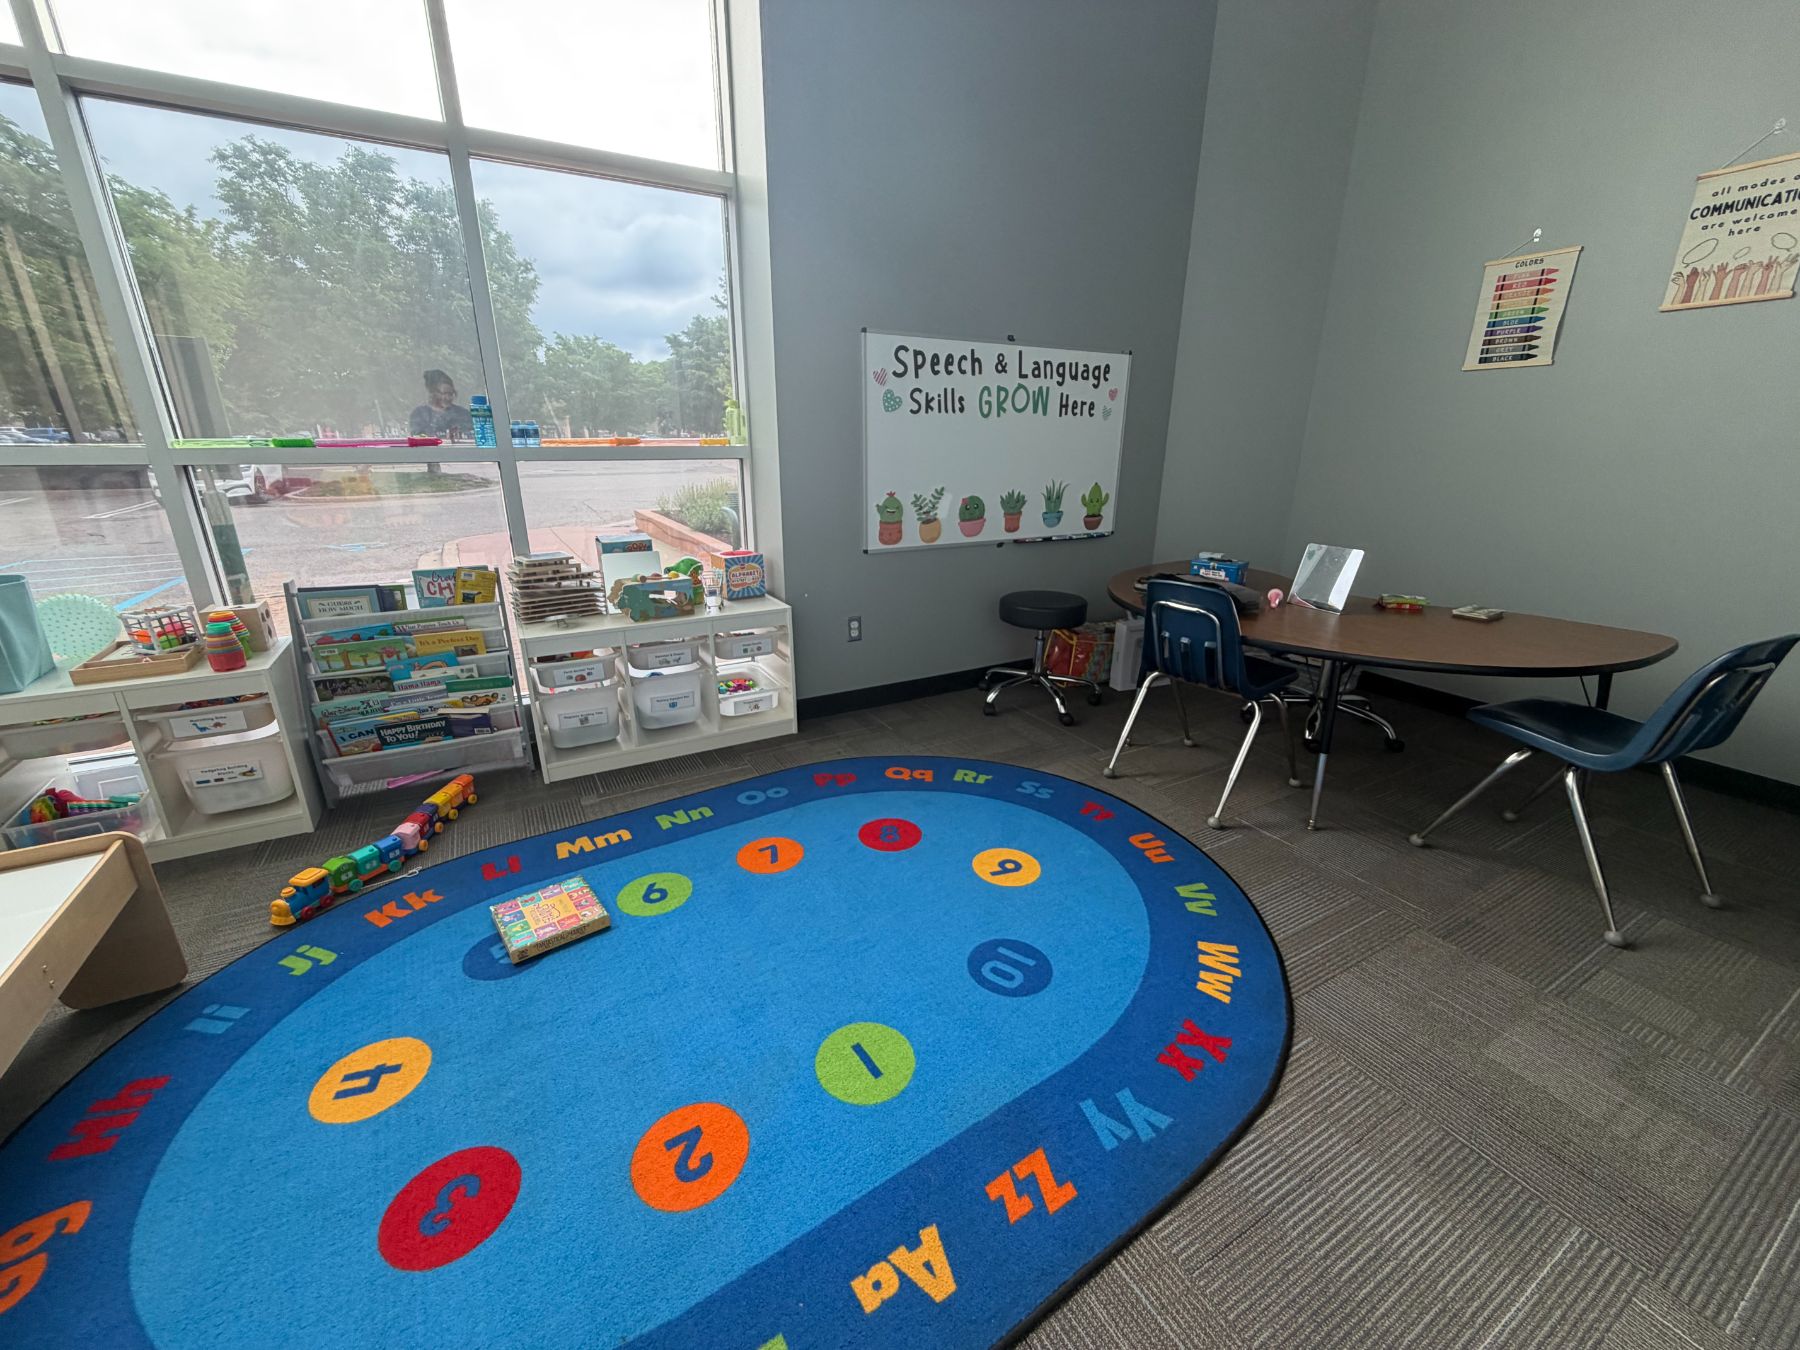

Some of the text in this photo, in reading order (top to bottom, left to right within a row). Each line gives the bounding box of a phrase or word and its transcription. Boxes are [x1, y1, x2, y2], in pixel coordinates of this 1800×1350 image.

[1712, 186, 1732, 197] all
[1738, 178, 1786, 192] modes
[1701, 209, 1798, 231] are welcome
[1728, 226, 1761, 237] here
[1515, 258, 1544, 269] COLORS
[892, 345, 1111, 388] Speech & Language
[909, 383, 1096, 418] Skills GROW Here
[339, 605, 364, 613] MUCH
[348, 728, 375, 739] CAN
[812, 772, 857, 788] Pp
[884, 766, 934, 783] Qq
[953, 769, 993, 786] Rr
[1015, 781, 1056, 800] Ss
[736, 784, 789, 806] Oo
[655, 805, 714, 832] Nn
[878, 825, 899, 844] 8
[556, 826, 632, 860] Mm
[758, 844, 781, 866] 7
[1128, 832, 1175, 865] Uu
[481, 855, 522, 881] Ll
[996, 858, 1024, 878] 9
[364, 888, 444, 928] Kk
[642, 881, 669, 905] 6
[1175, 883, 1219, 917] Vv
[278, 944, 338, 977] Jj
[981, 946, 1037, 989] 10
[1196, 940, 1242, 1004] Ww
[184, 1004, 253, 1035] Ii
[851, 1041, 884, 1079] 1
[1155, 1018, 1233, 1083] Xx
[332, 1063, 403, 1101] 4
[46, 1075, 171, 1161] Hh
[1078, 1086, 1175, 1151] Yy
[664, 1125, 714, 1183] 2
[984, 1146, 1078, 1224] Zz
[419, 1173, 481, 1236] 3
[850, 1223, 957, 1314] Aa
